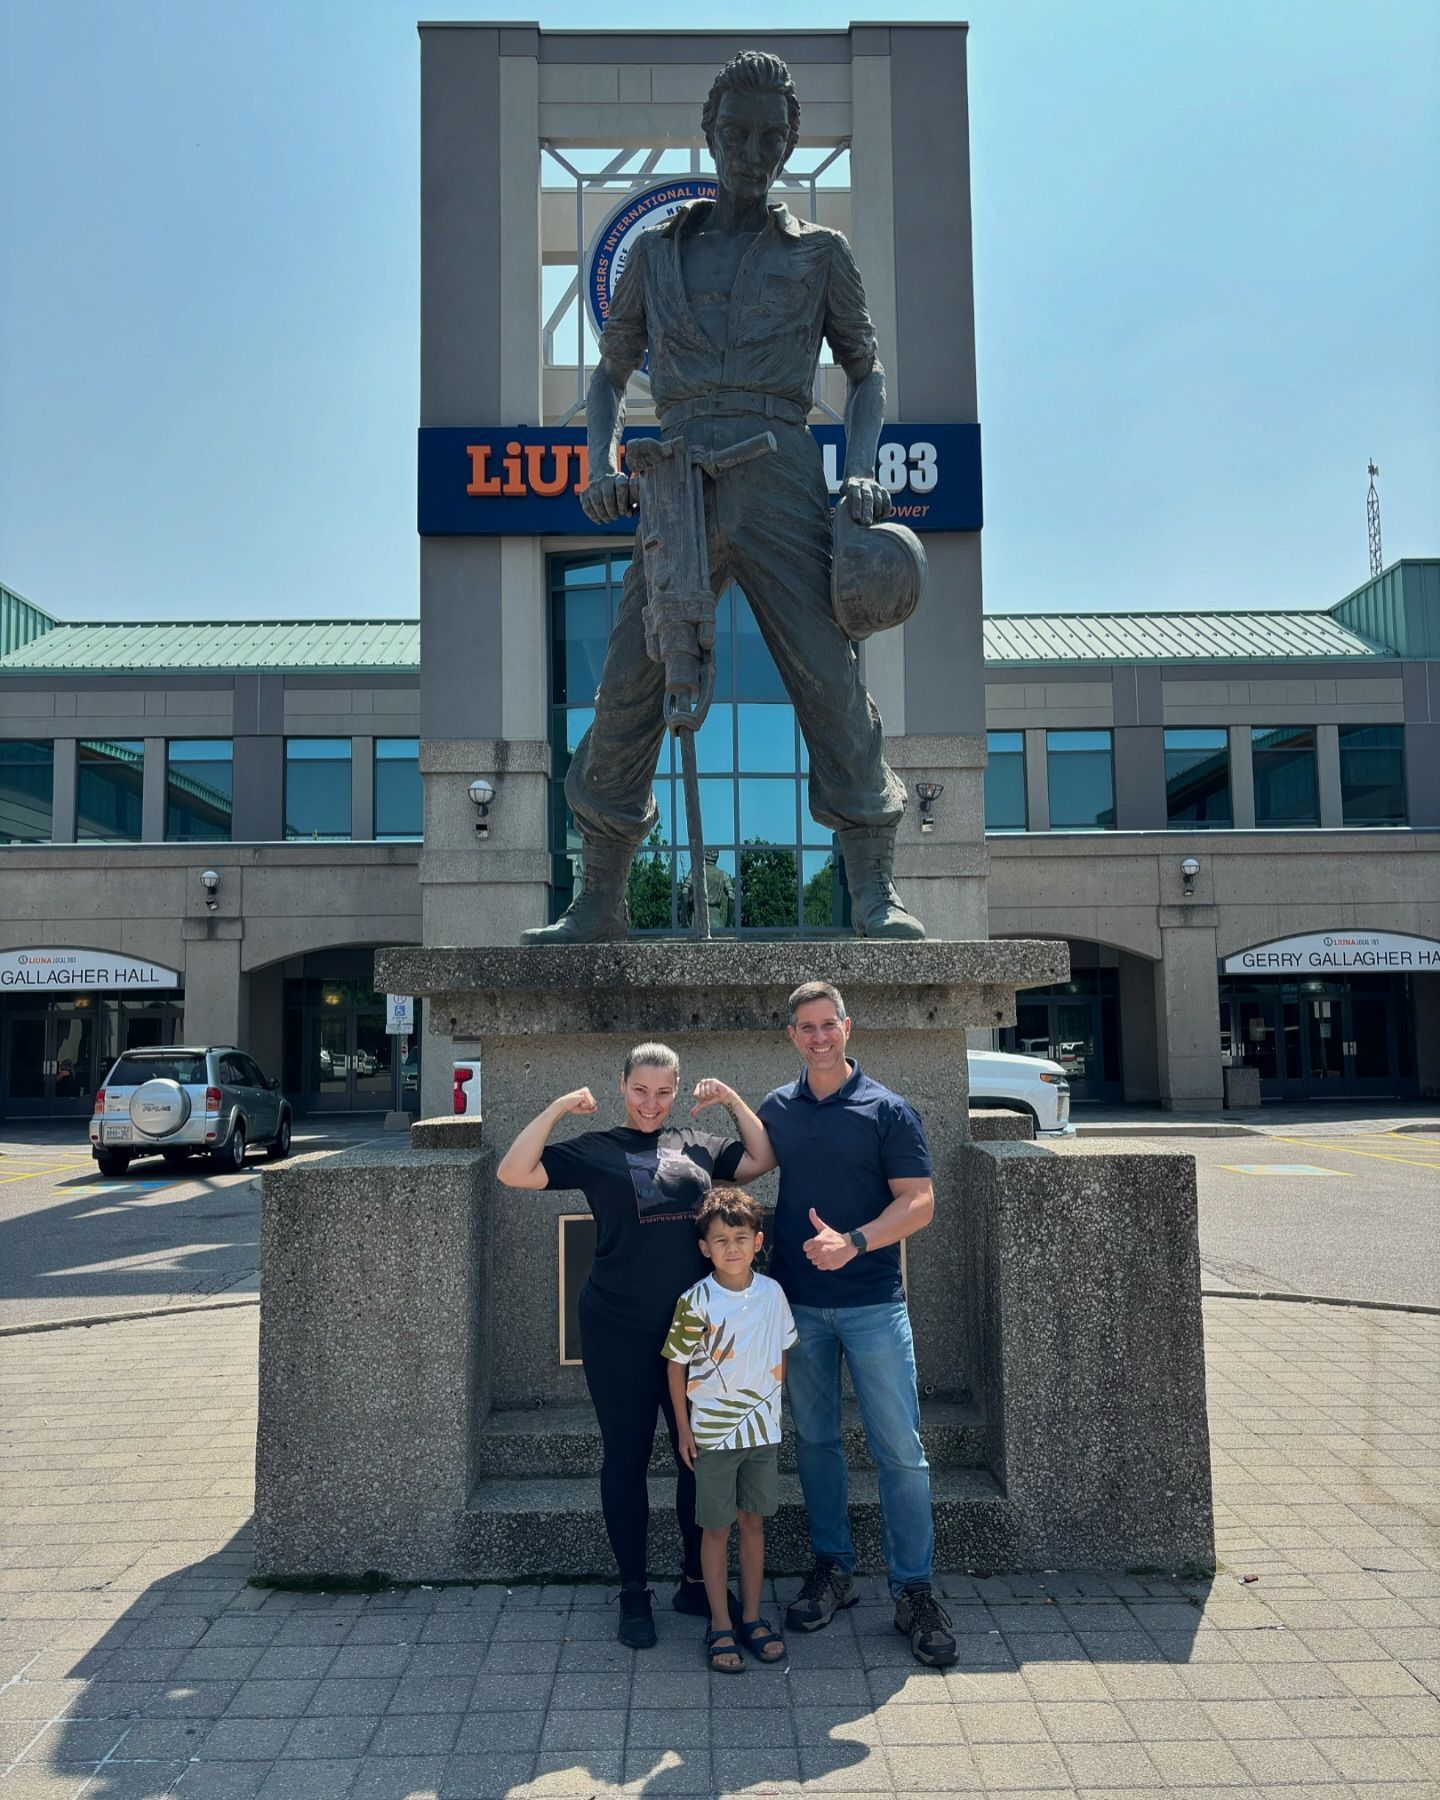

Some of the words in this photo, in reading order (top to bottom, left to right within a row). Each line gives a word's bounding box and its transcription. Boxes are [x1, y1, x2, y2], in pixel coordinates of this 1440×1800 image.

[596, 255, 609, 319] BOURERS'
[604, 187, 693, 252] INTERNATIONAL
[878, 442, 939, 494] 83
[888, 504, 930, 518] ower
[1242, 953, 1303, 968] GERRY
[1309, 951, 1412, 967] GALLAGHER
[1, 969, 109, 985] GALLAGHER
[114, 968, 160, 983] HALL
